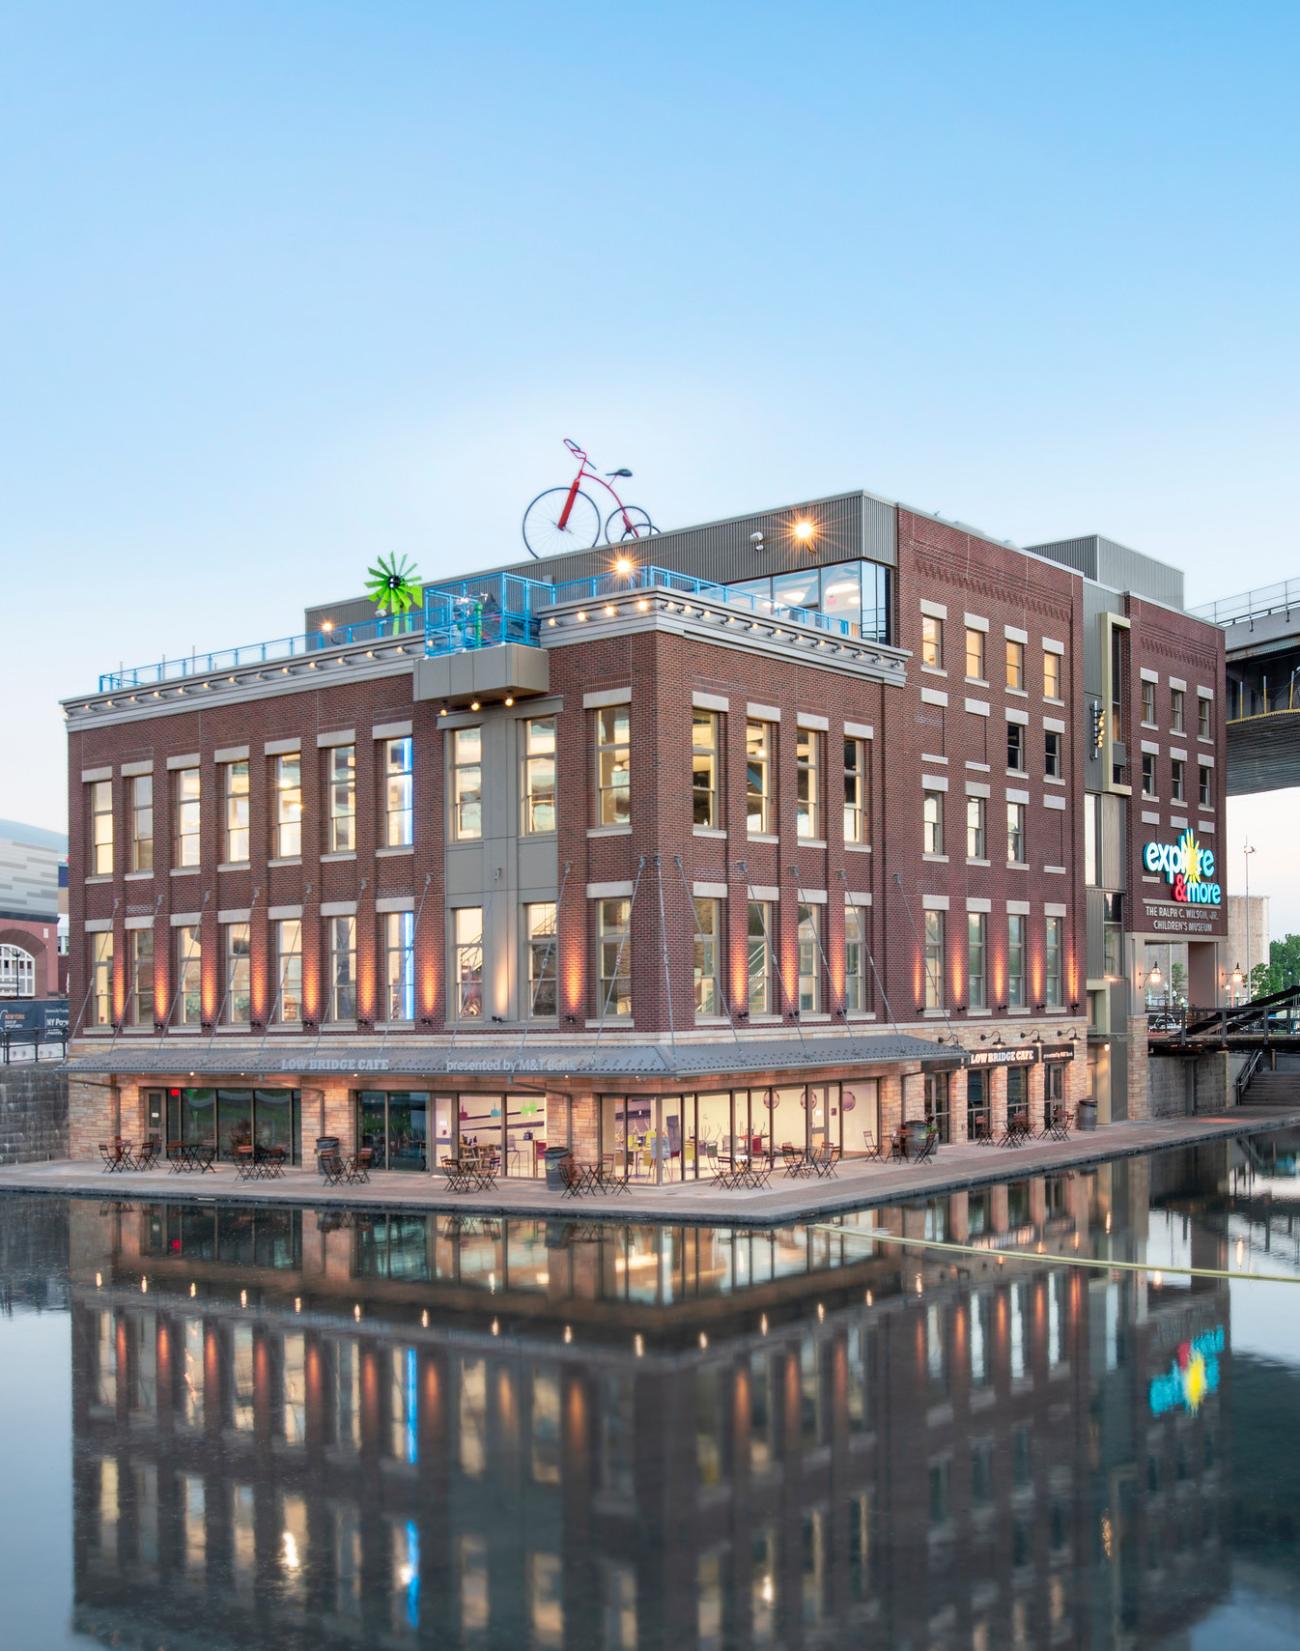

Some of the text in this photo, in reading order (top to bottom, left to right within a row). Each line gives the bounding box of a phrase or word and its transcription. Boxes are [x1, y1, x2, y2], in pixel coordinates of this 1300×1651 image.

[1145, 906, 1158, 917] THE
[1159, 907, 1178, 918] RALPH
[1179, 909, 1185, 918] C.
[1153, 920, 1188, 931] CHILDREN'S
[971, 1053, 988, 1064] LOW
[988, 1051, 1016, 1063] BRIDGE
[1016, 1050, 1034, 1060] CAFE
[281, 1059, 389, 1070] LOW BRIDGE CAFE
[446, 1060, 500, 1072] presented
[503, 1059, 517, 1072] by
[519, 1060, 544, 1071] M&T
